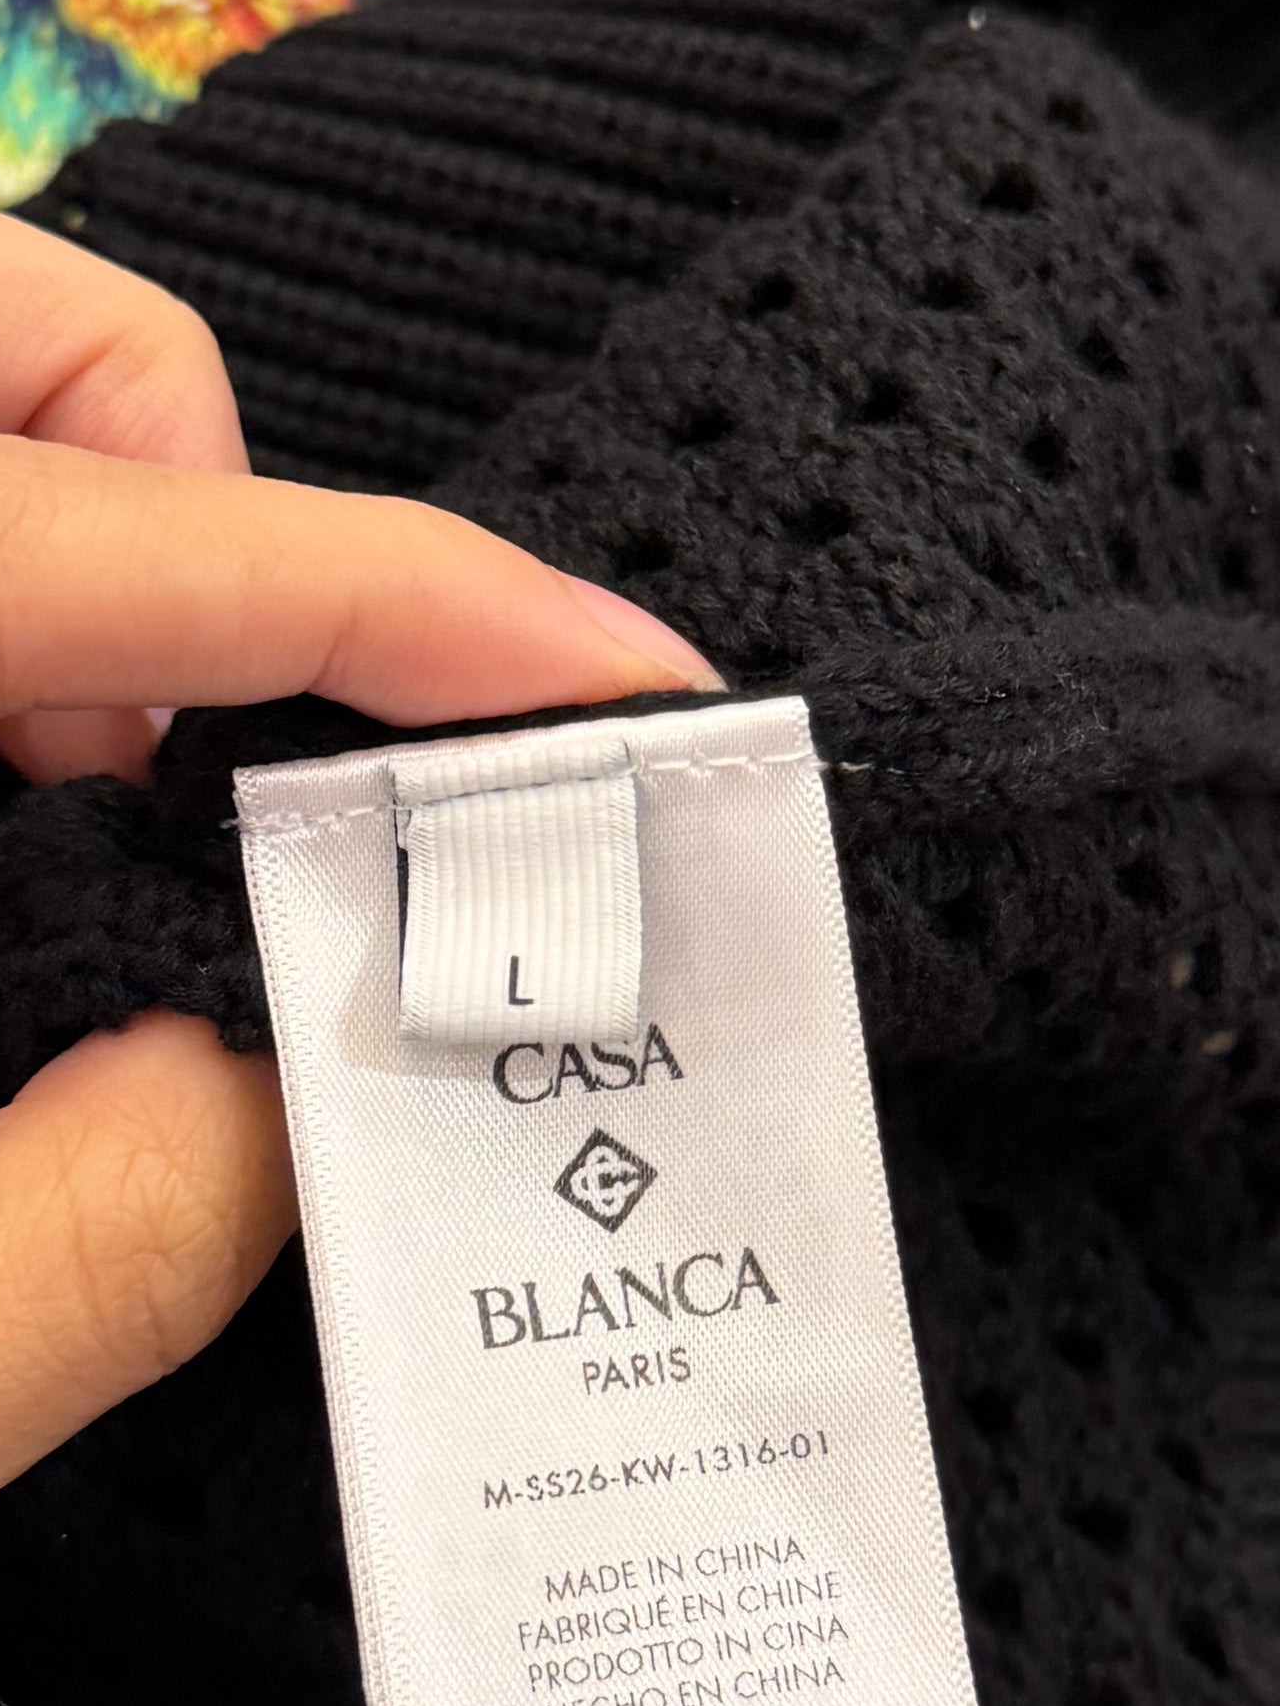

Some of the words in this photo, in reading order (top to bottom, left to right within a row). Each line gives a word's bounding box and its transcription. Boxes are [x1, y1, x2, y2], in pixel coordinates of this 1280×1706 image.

[507, 955, 535, 1006] L
[492, 1021, 685, 1105] CASA
[469, 1246, 782, 1350] BLANCA
[582, 1346, 692, 1395] PARIS
[483, 1429, 829, 1509] M-SS26-KW-1316-01
[545, 1560, 639, 1603] MADE
[647, 1554, 685, 1586] IN
[695, 1535, 806, 1576] CHINA
[517, 1594, 673, 1651] FABRIQUÉ
[682, 1590, 727, 1624] EN
[737, 1570, 844, 1613] CHINE
[528, 1637, 705, 1693] PRODOTTO
[714, 1628, 753, 1661] IN
[763, 1613, 850, 1651] CINA
[734, 1655, 846, 1699] CHINA
